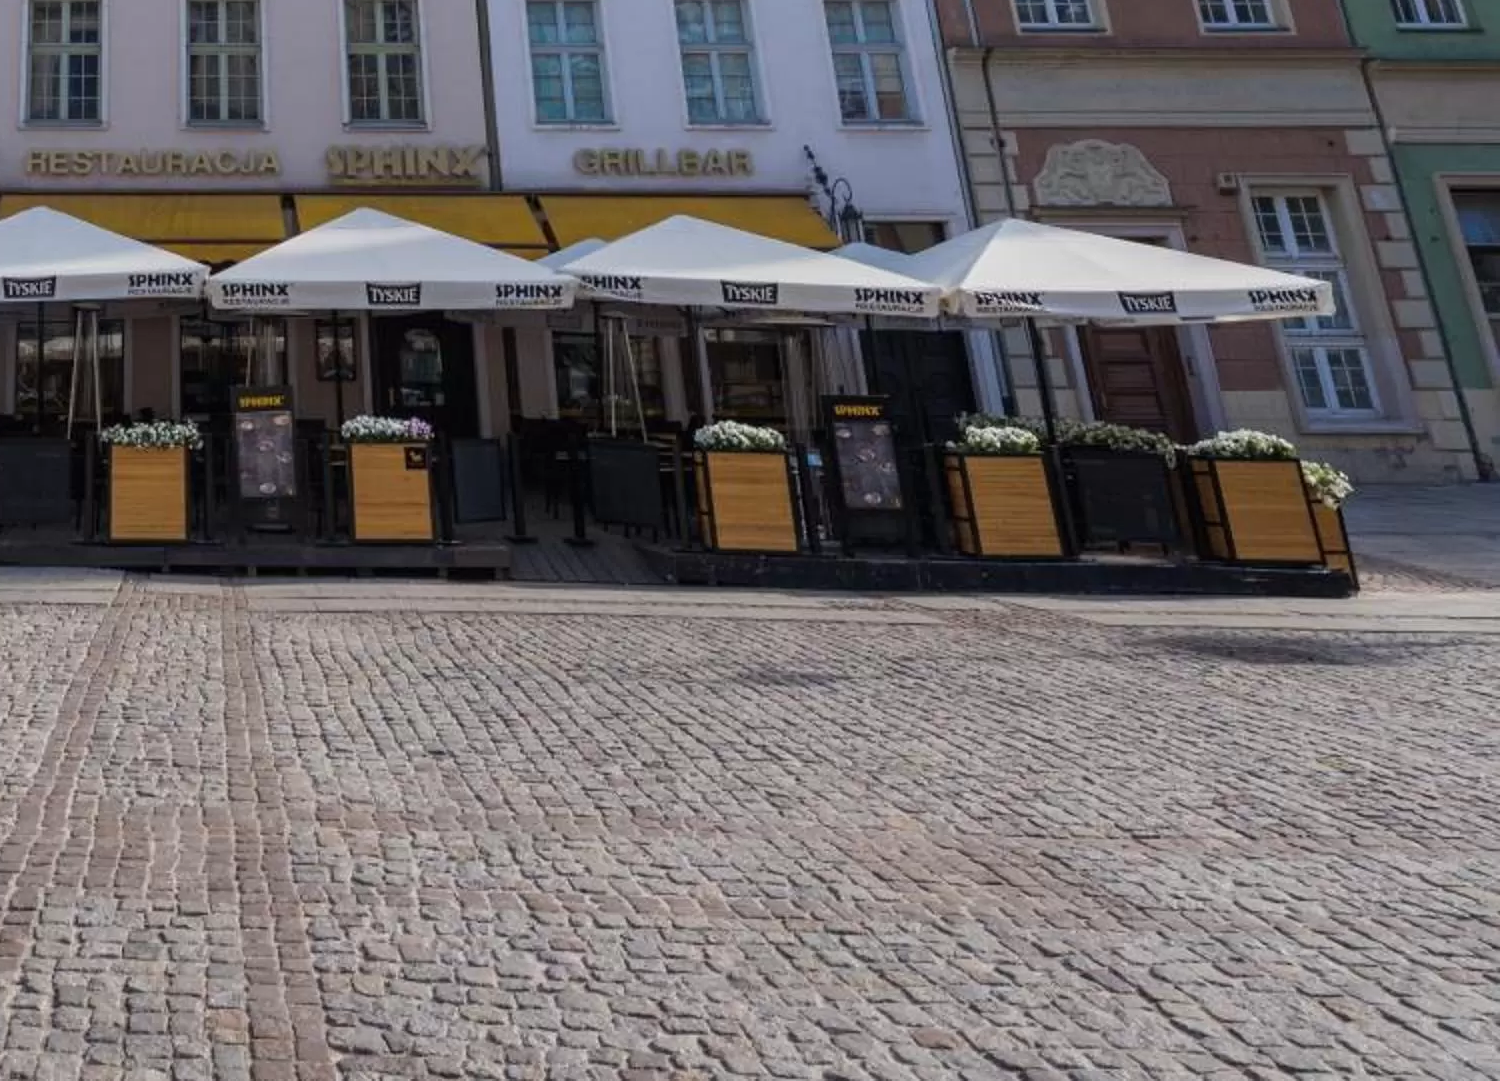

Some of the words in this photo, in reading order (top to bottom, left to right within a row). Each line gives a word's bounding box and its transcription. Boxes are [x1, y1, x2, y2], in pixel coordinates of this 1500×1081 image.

[26, 150, 282, 176] RESTAURACJA
[326, 146, 486, 177] SPHINX
[128, 273, 193, 288] SPHINX
[581, 275, 642, 289] PHINX
[7, 281, 54, 298] TYSKIE
[221, 283, 289, 297] SPHINX
[368, 286, 418, 303] TYSKIE
[495, 284, 563, 298] SPHINX
[725, 284, 776, 302] TYSKIE
[854, 288, 925, 305] SPHINX
[1248, 289, 1318, 303] SPHINX
[974, 291, 1043, 306] SPHINX
[1124, 295, 1175, 312] TYSKIE
